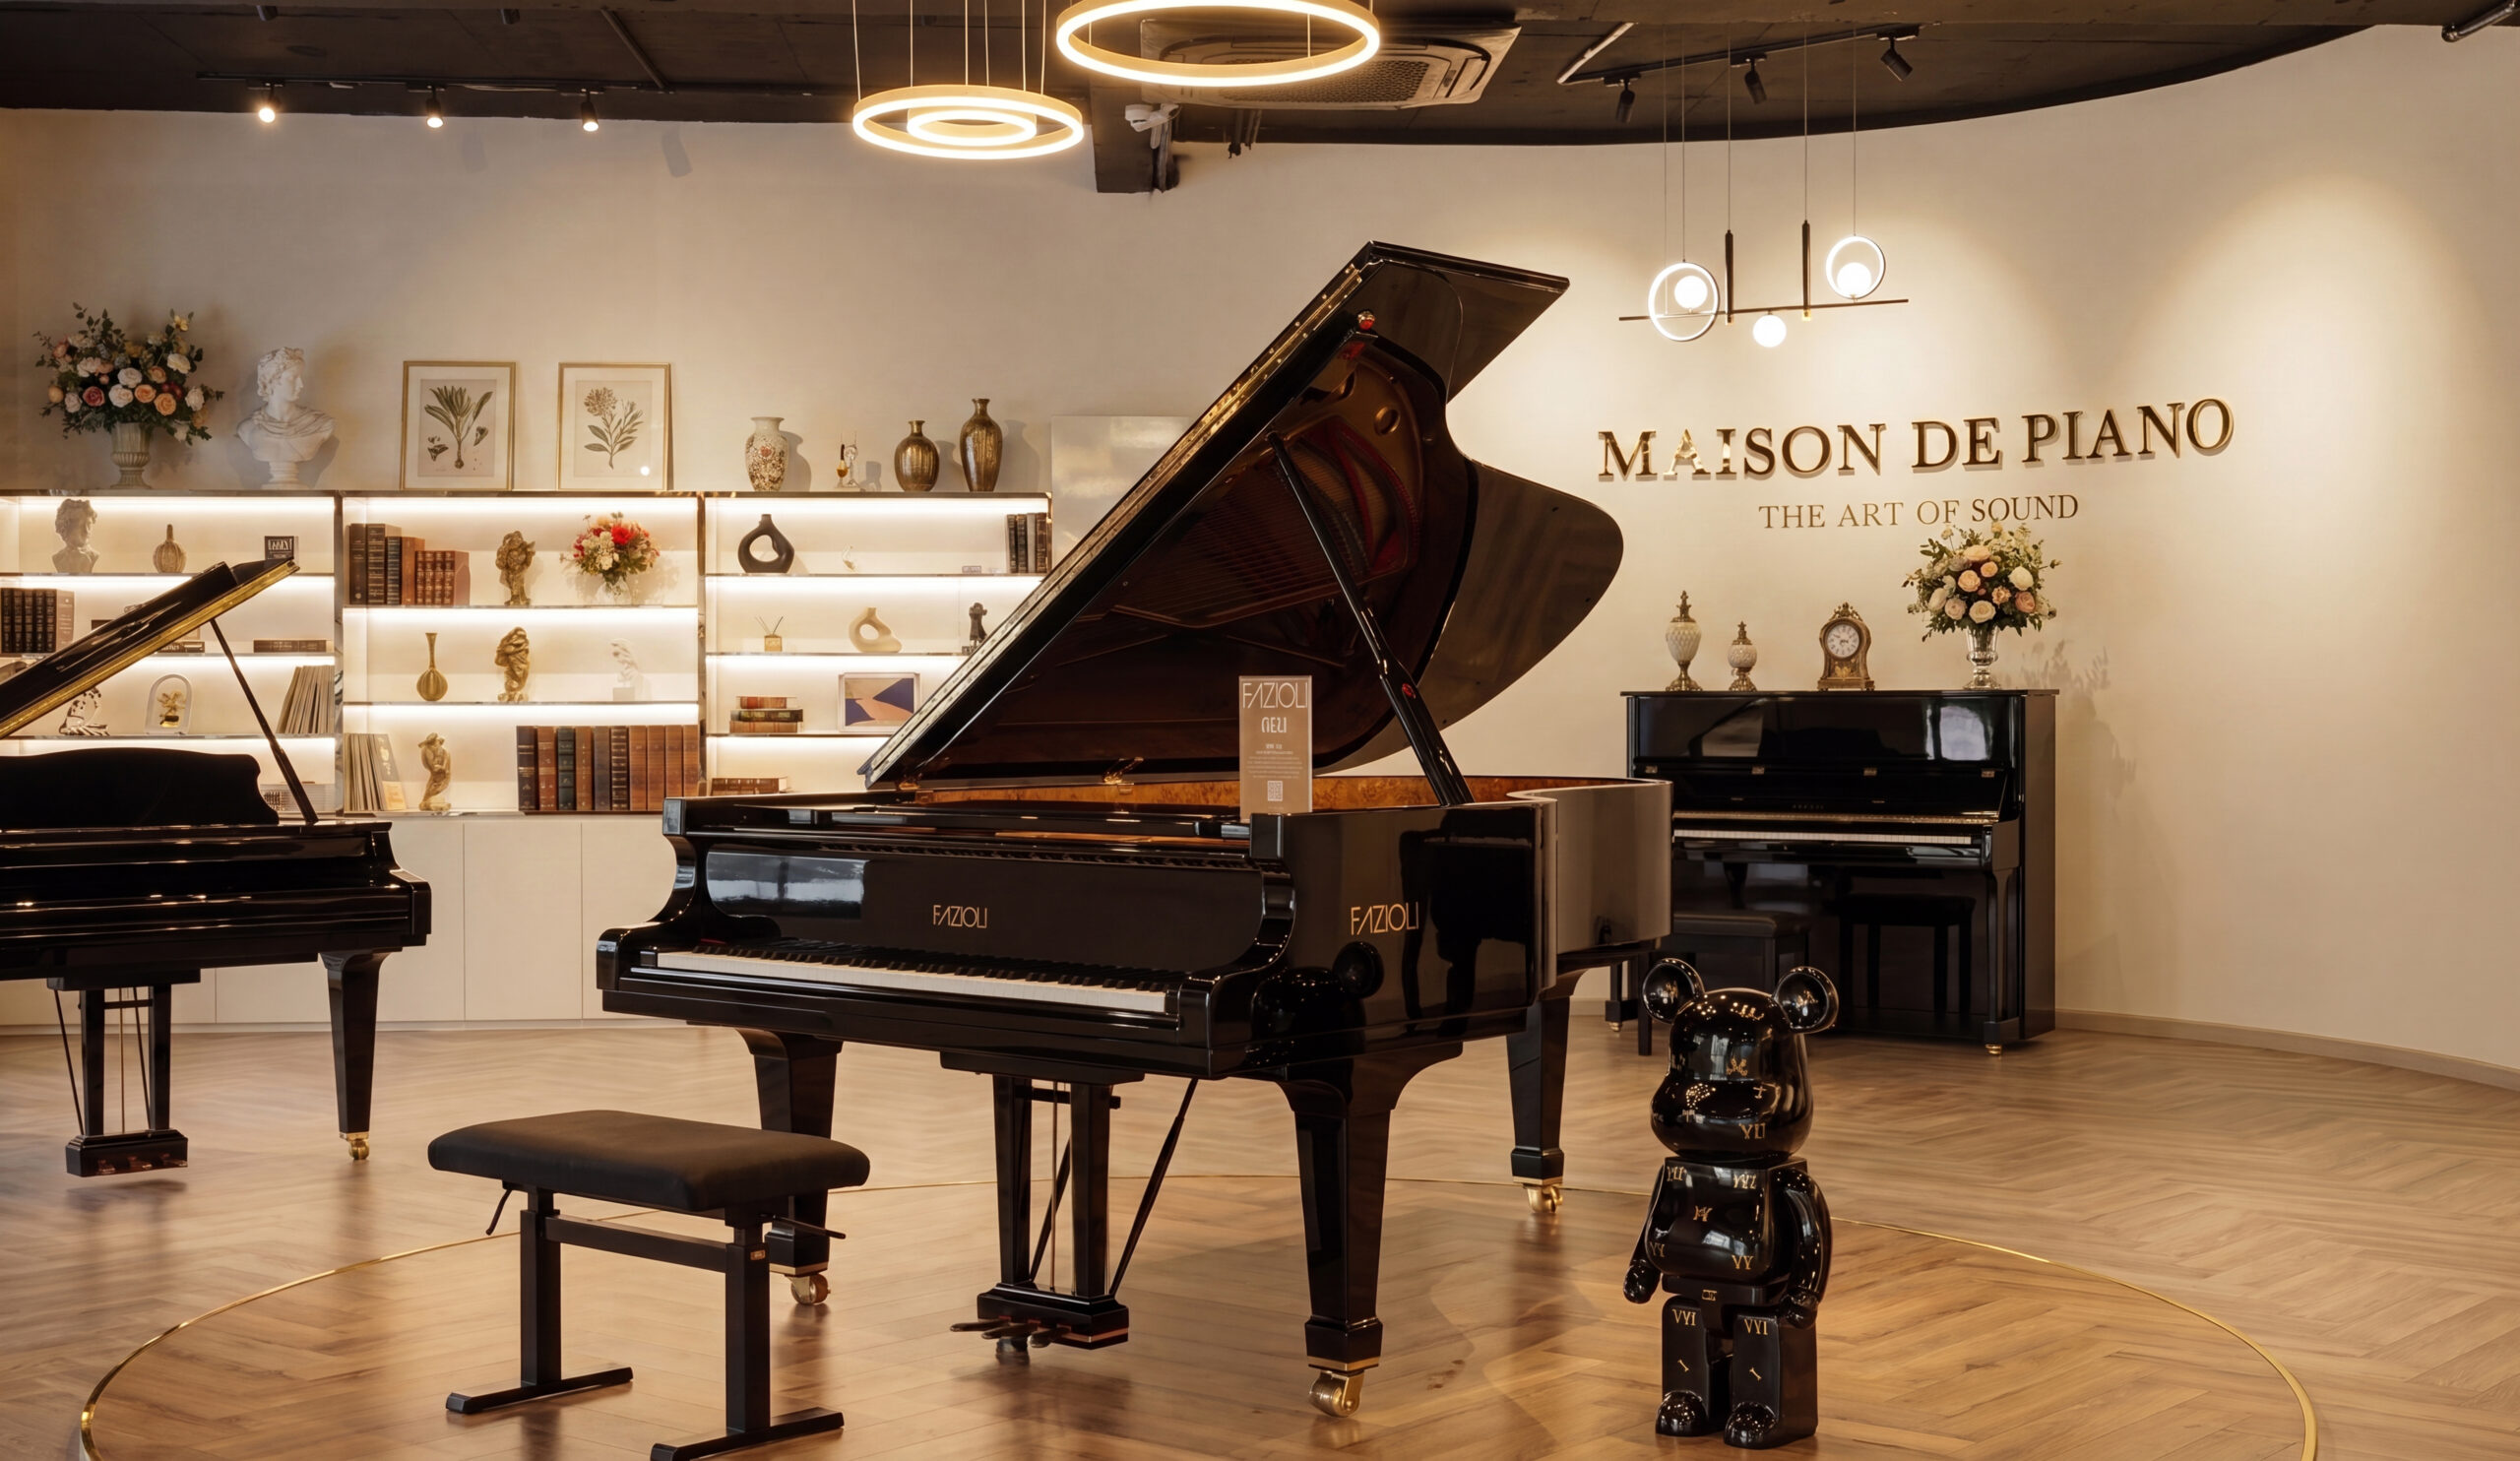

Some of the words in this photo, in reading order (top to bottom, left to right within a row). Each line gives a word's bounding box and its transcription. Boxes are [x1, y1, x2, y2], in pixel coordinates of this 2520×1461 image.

[1598, 423, 1886, 479] MAISON
[1911, 416, 2002, 471] DE
[2021, 398, 2234, 464] PIANO
[1758, 504, 1825, 529] THE
[1837, 502, 1904, 527] ART
[1917, 499, 1960, 525] OF
[1971, 494, 2078, 522] SOUND
[1242, 682, 1308, 709] FAZIOLI
[932, 905, 988, 928] FAZIOLI
[1351, 901, 1419, 936] FAZIOLI
